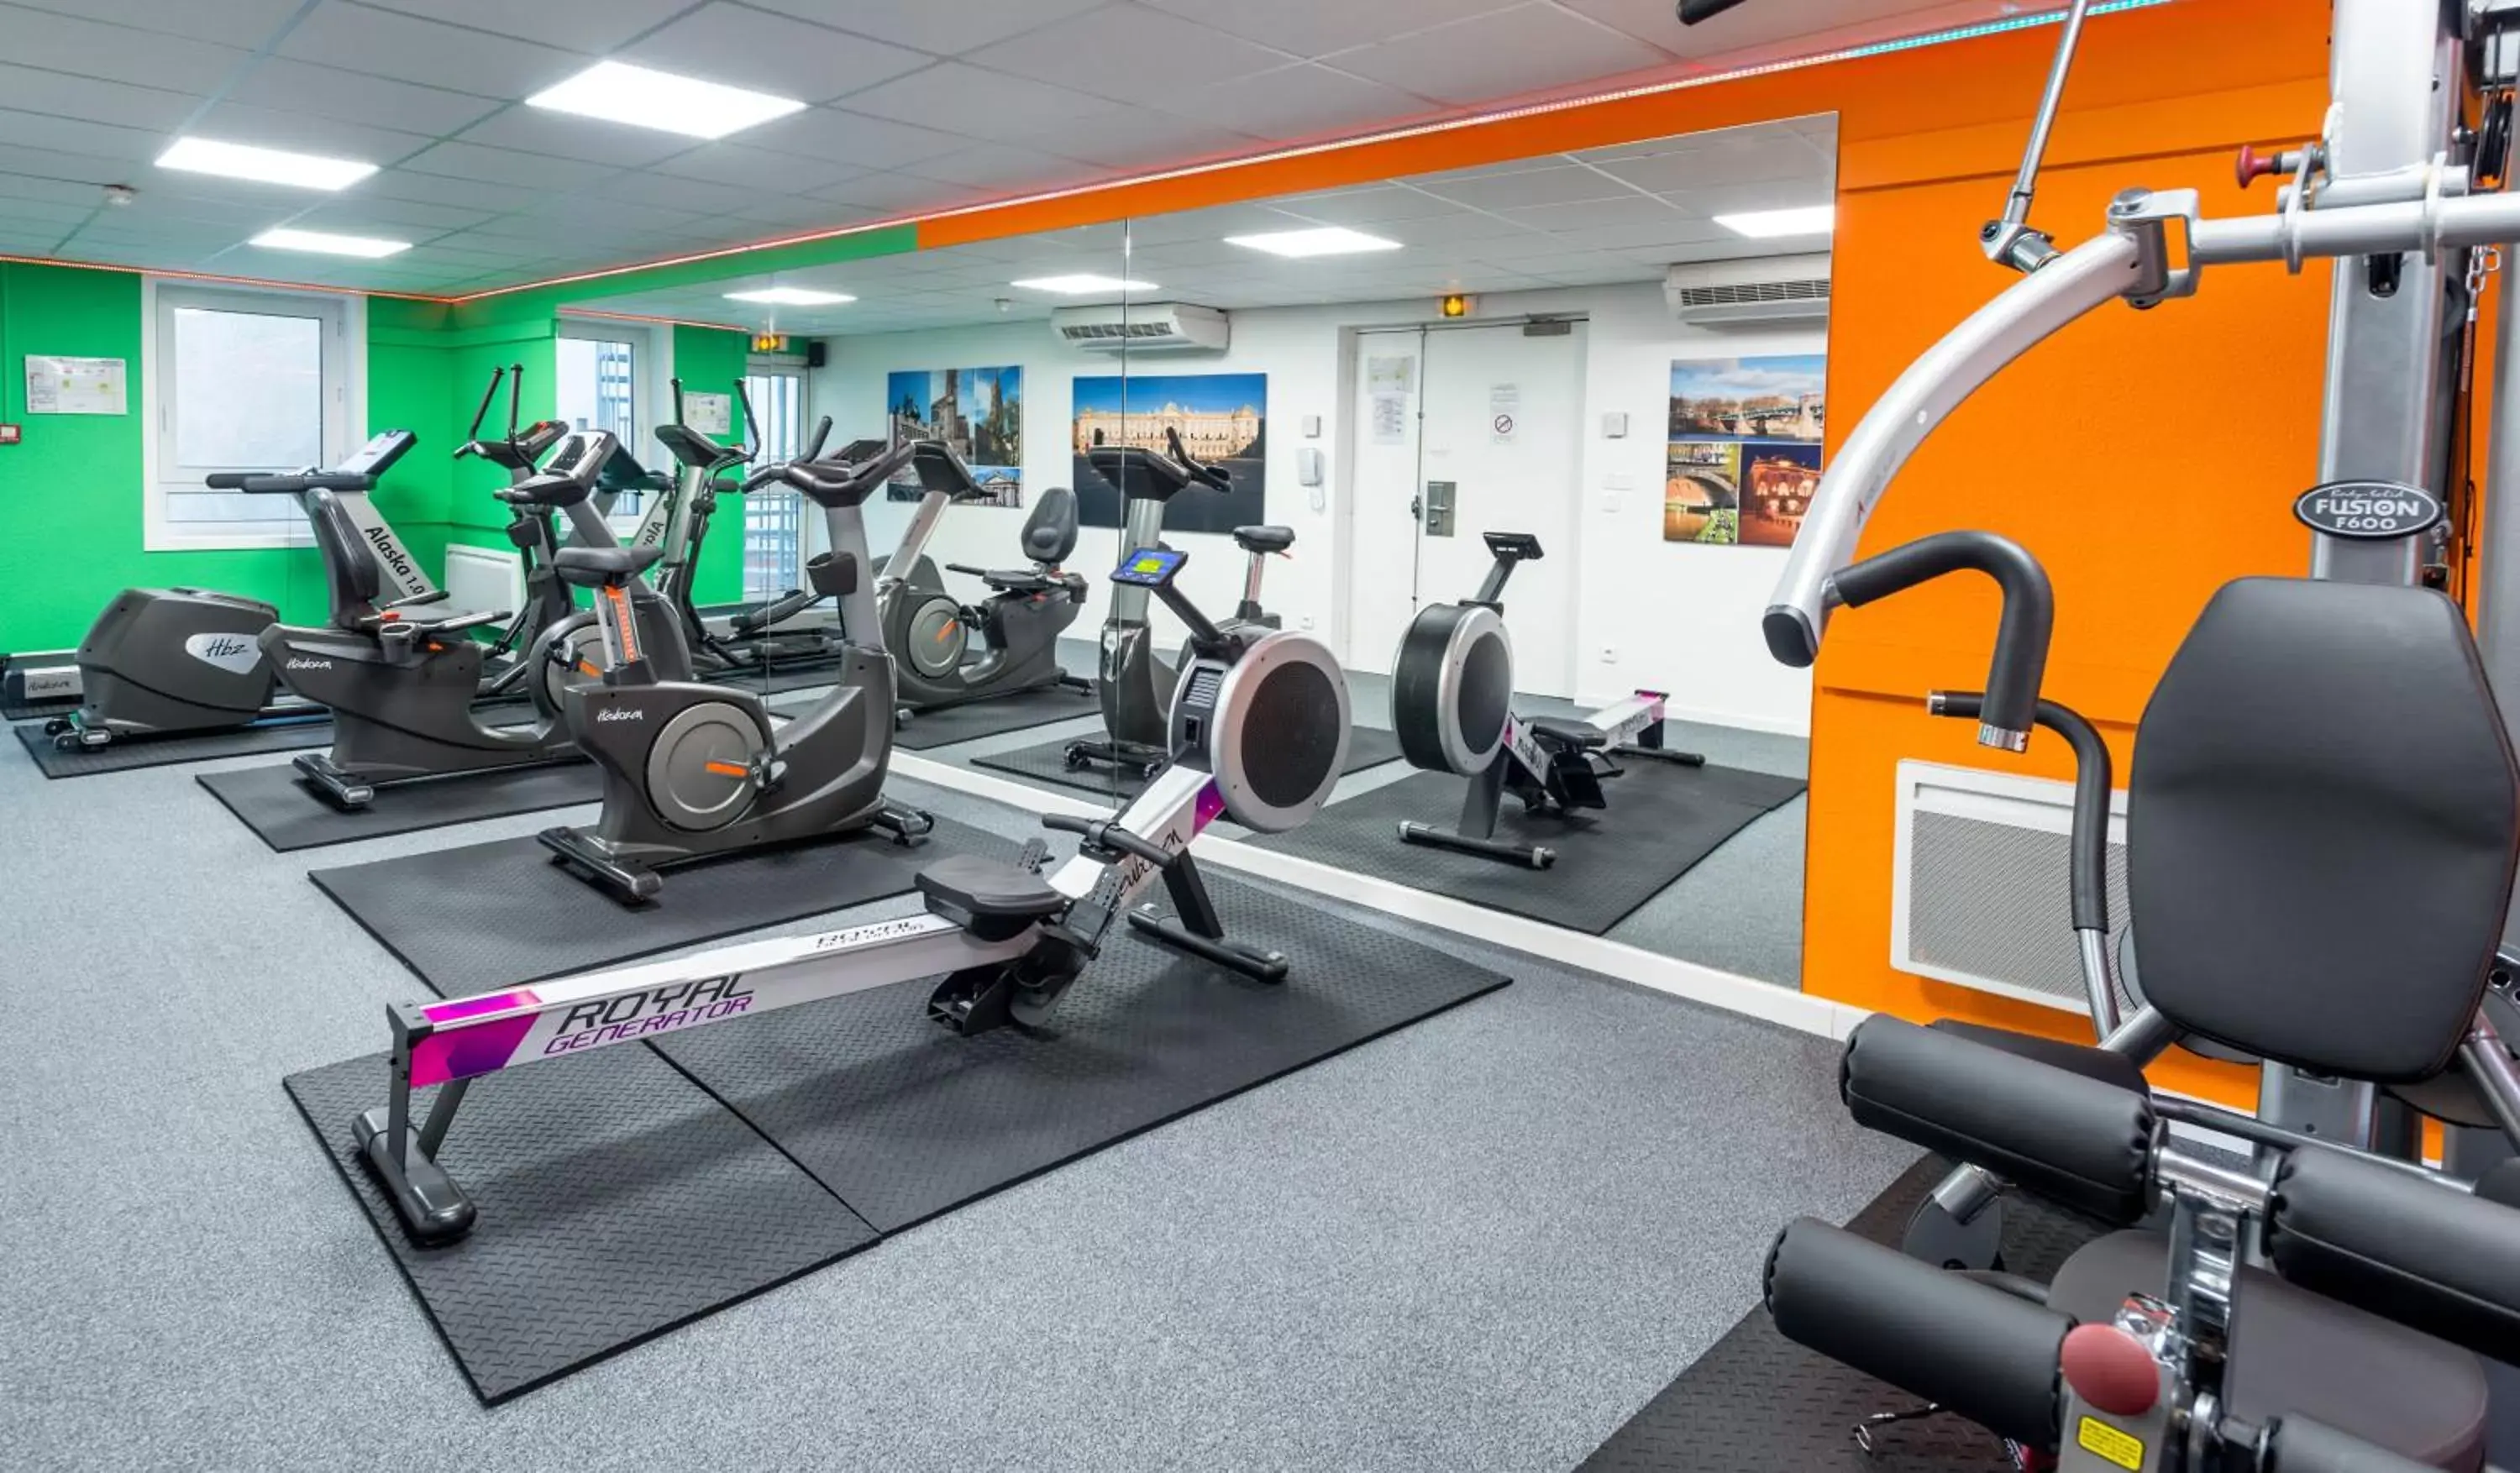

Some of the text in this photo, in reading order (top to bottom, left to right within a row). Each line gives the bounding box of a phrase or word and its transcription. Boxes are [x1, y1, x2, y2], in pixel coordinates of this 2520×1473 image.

[2315, 498, 2421, 516] FUSION
[2335, 516, 2397, 530] F600
[364, 527, 425, 595] Alaska 1.0
[543, 995, 753, 1055] GENERATOR
[556, 972, 754, 1035] ROYAL
